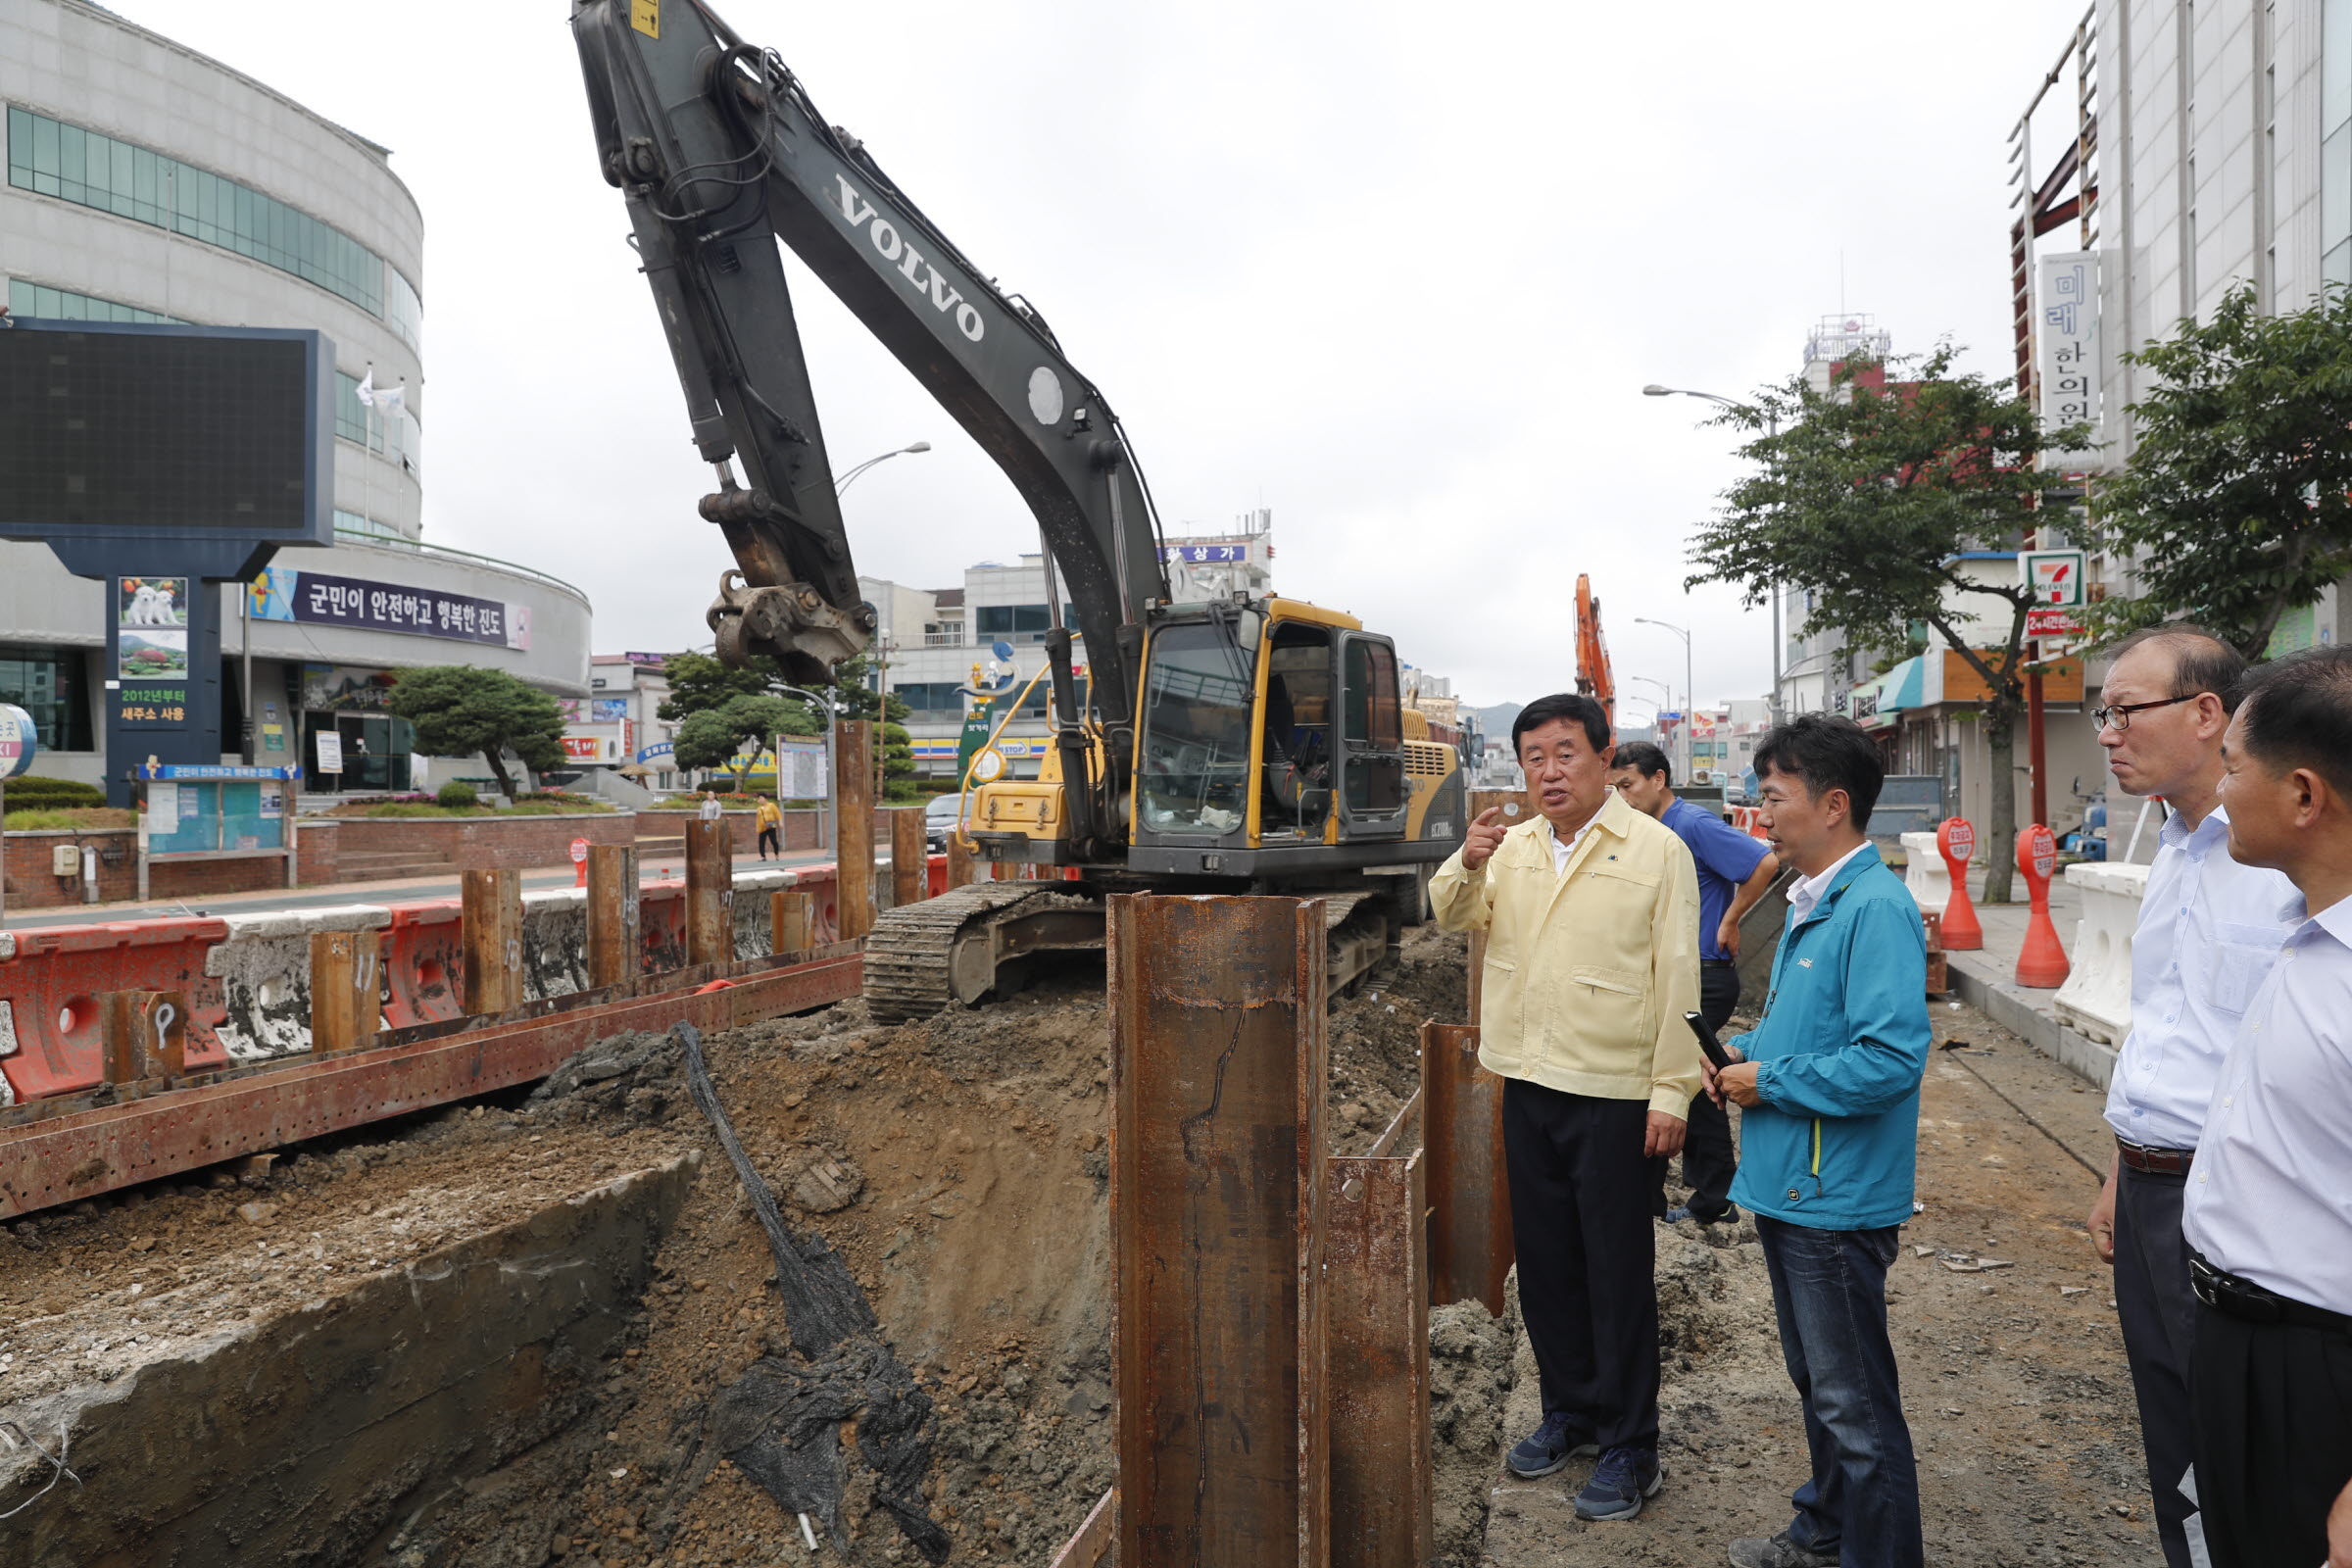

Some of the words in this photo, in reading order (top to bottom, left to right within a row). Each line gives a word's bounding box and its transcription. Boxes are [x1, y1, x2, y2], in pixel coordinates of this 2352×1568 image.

[836, 172, 984, 342] VOLVO
[310, 584, 365, 618] 군민이
[370, 591, 432, 625] 안전하고
[437, 601, 475, 634] 행복한
[478, 609, 501, 635] 진도
[122, 689, 186, 703] 2012년부터
[122, 707, 157, 720] 새주소
[161, 707, 185, 721] 사용
[173, 766, 199, 777] 군민이
[200, 767, 232, 777] 안전하고
